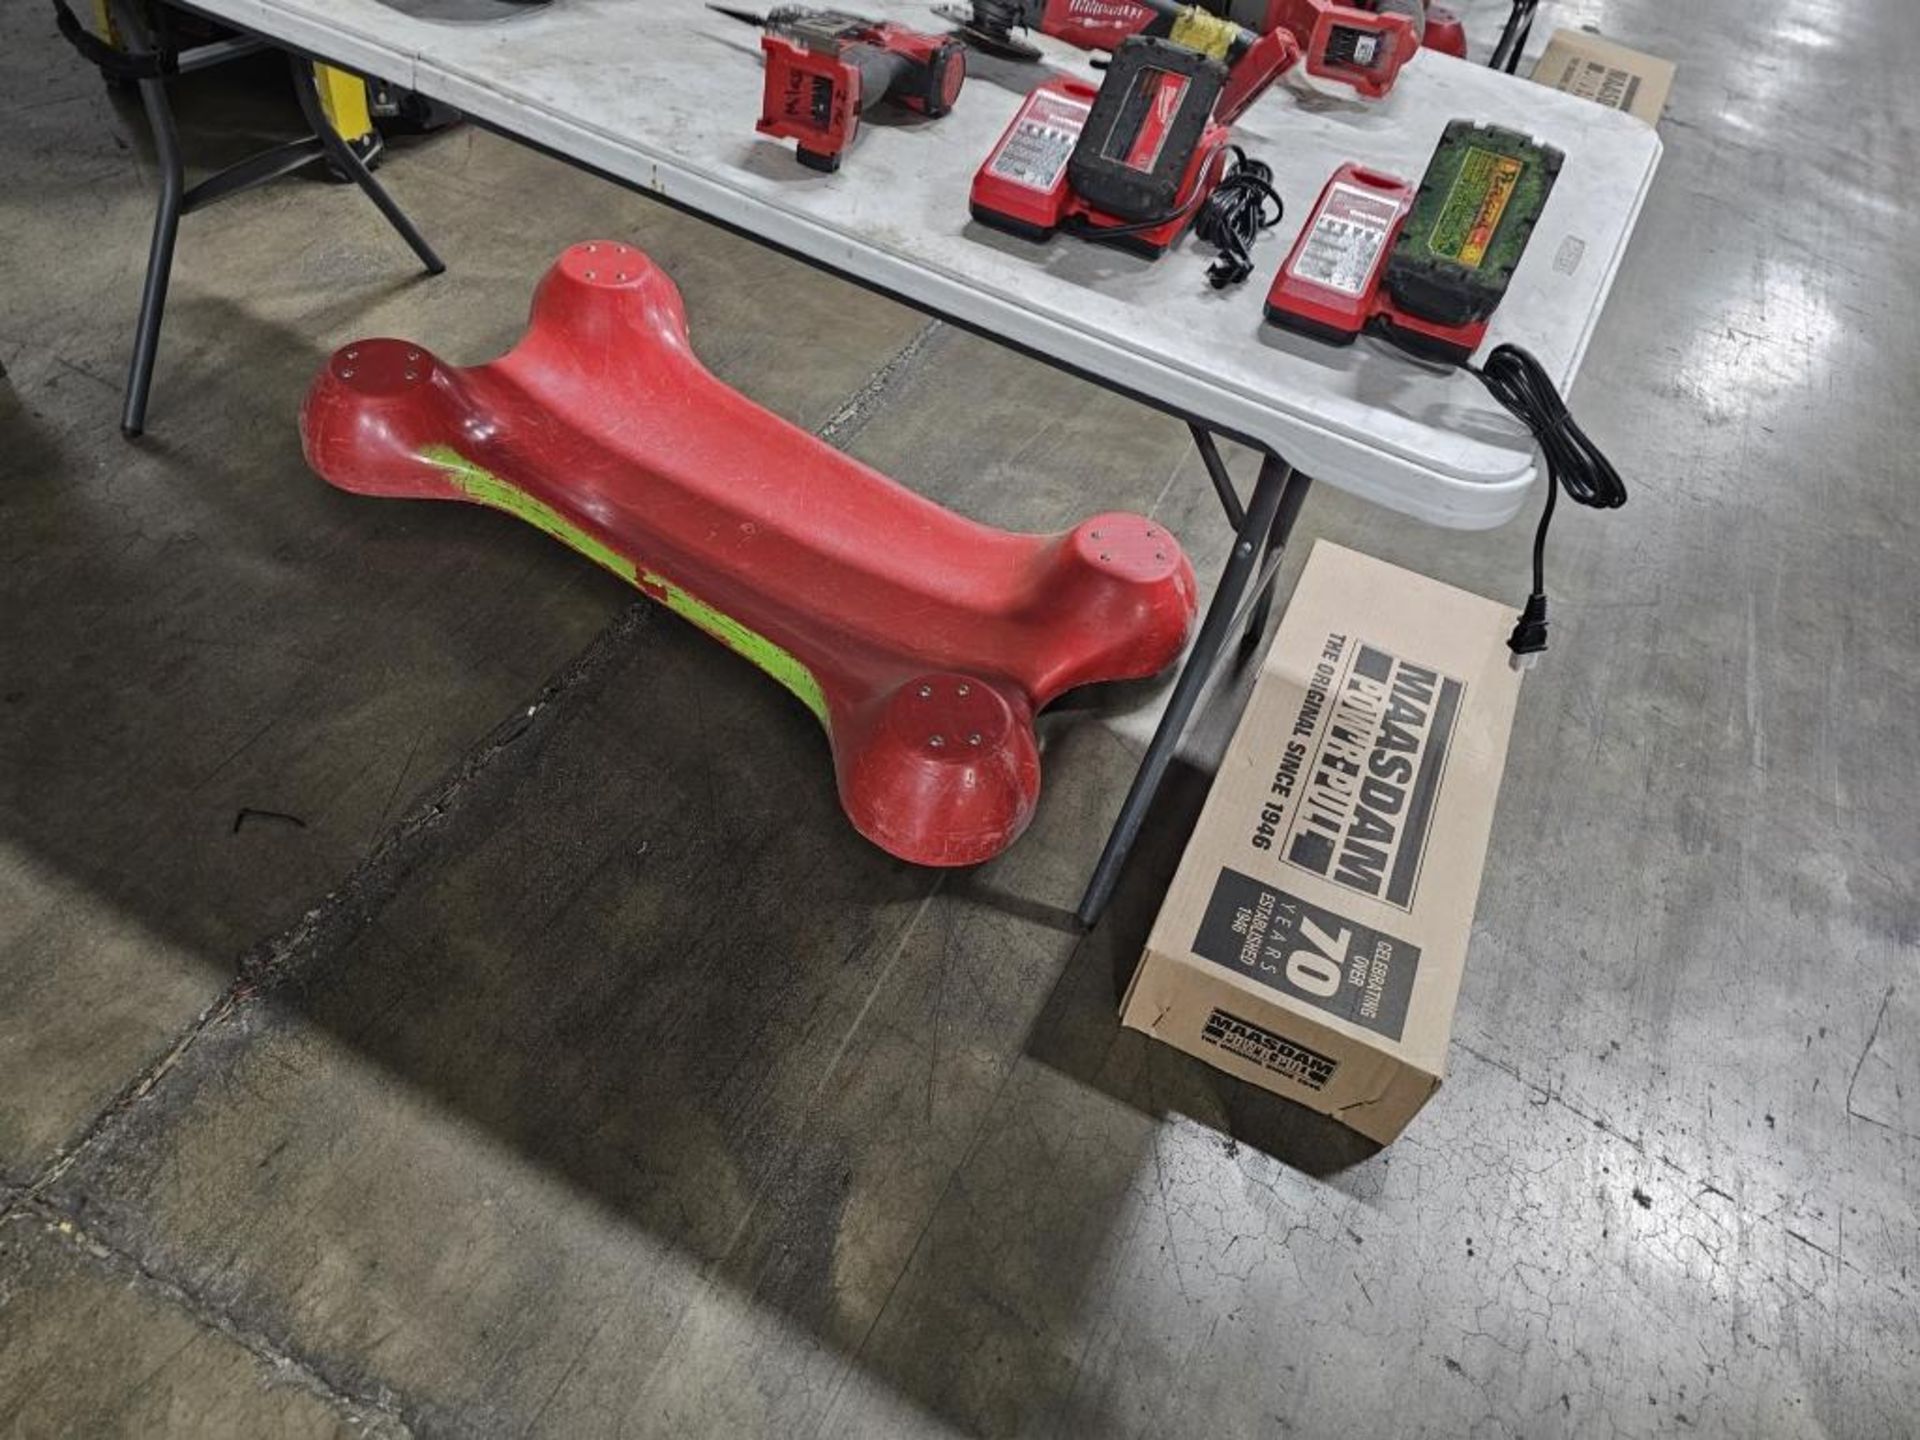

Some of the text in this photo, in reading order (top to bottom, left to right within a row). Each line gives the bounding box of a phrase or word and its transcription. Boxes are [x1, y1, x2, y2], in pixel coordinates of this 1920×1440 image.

[1252, 632, 1347, 851] THE ORIGINAL SINCE 1946
[1332, 659, 1438, 898] MAASDAM
[1231, 906, 1251, 934] 1946
[1240, 892, 1275, 966] ESTABLISHED
[1260, 902, 1296, 974] YEARS
[1286, 915, 1352, 997] 70
[1348, 955, 1369, 987] OVER
[1360, 940, 1392, 1019] CELEBRATING
[1208, 1014, 1333, 1075] MAASDAM
